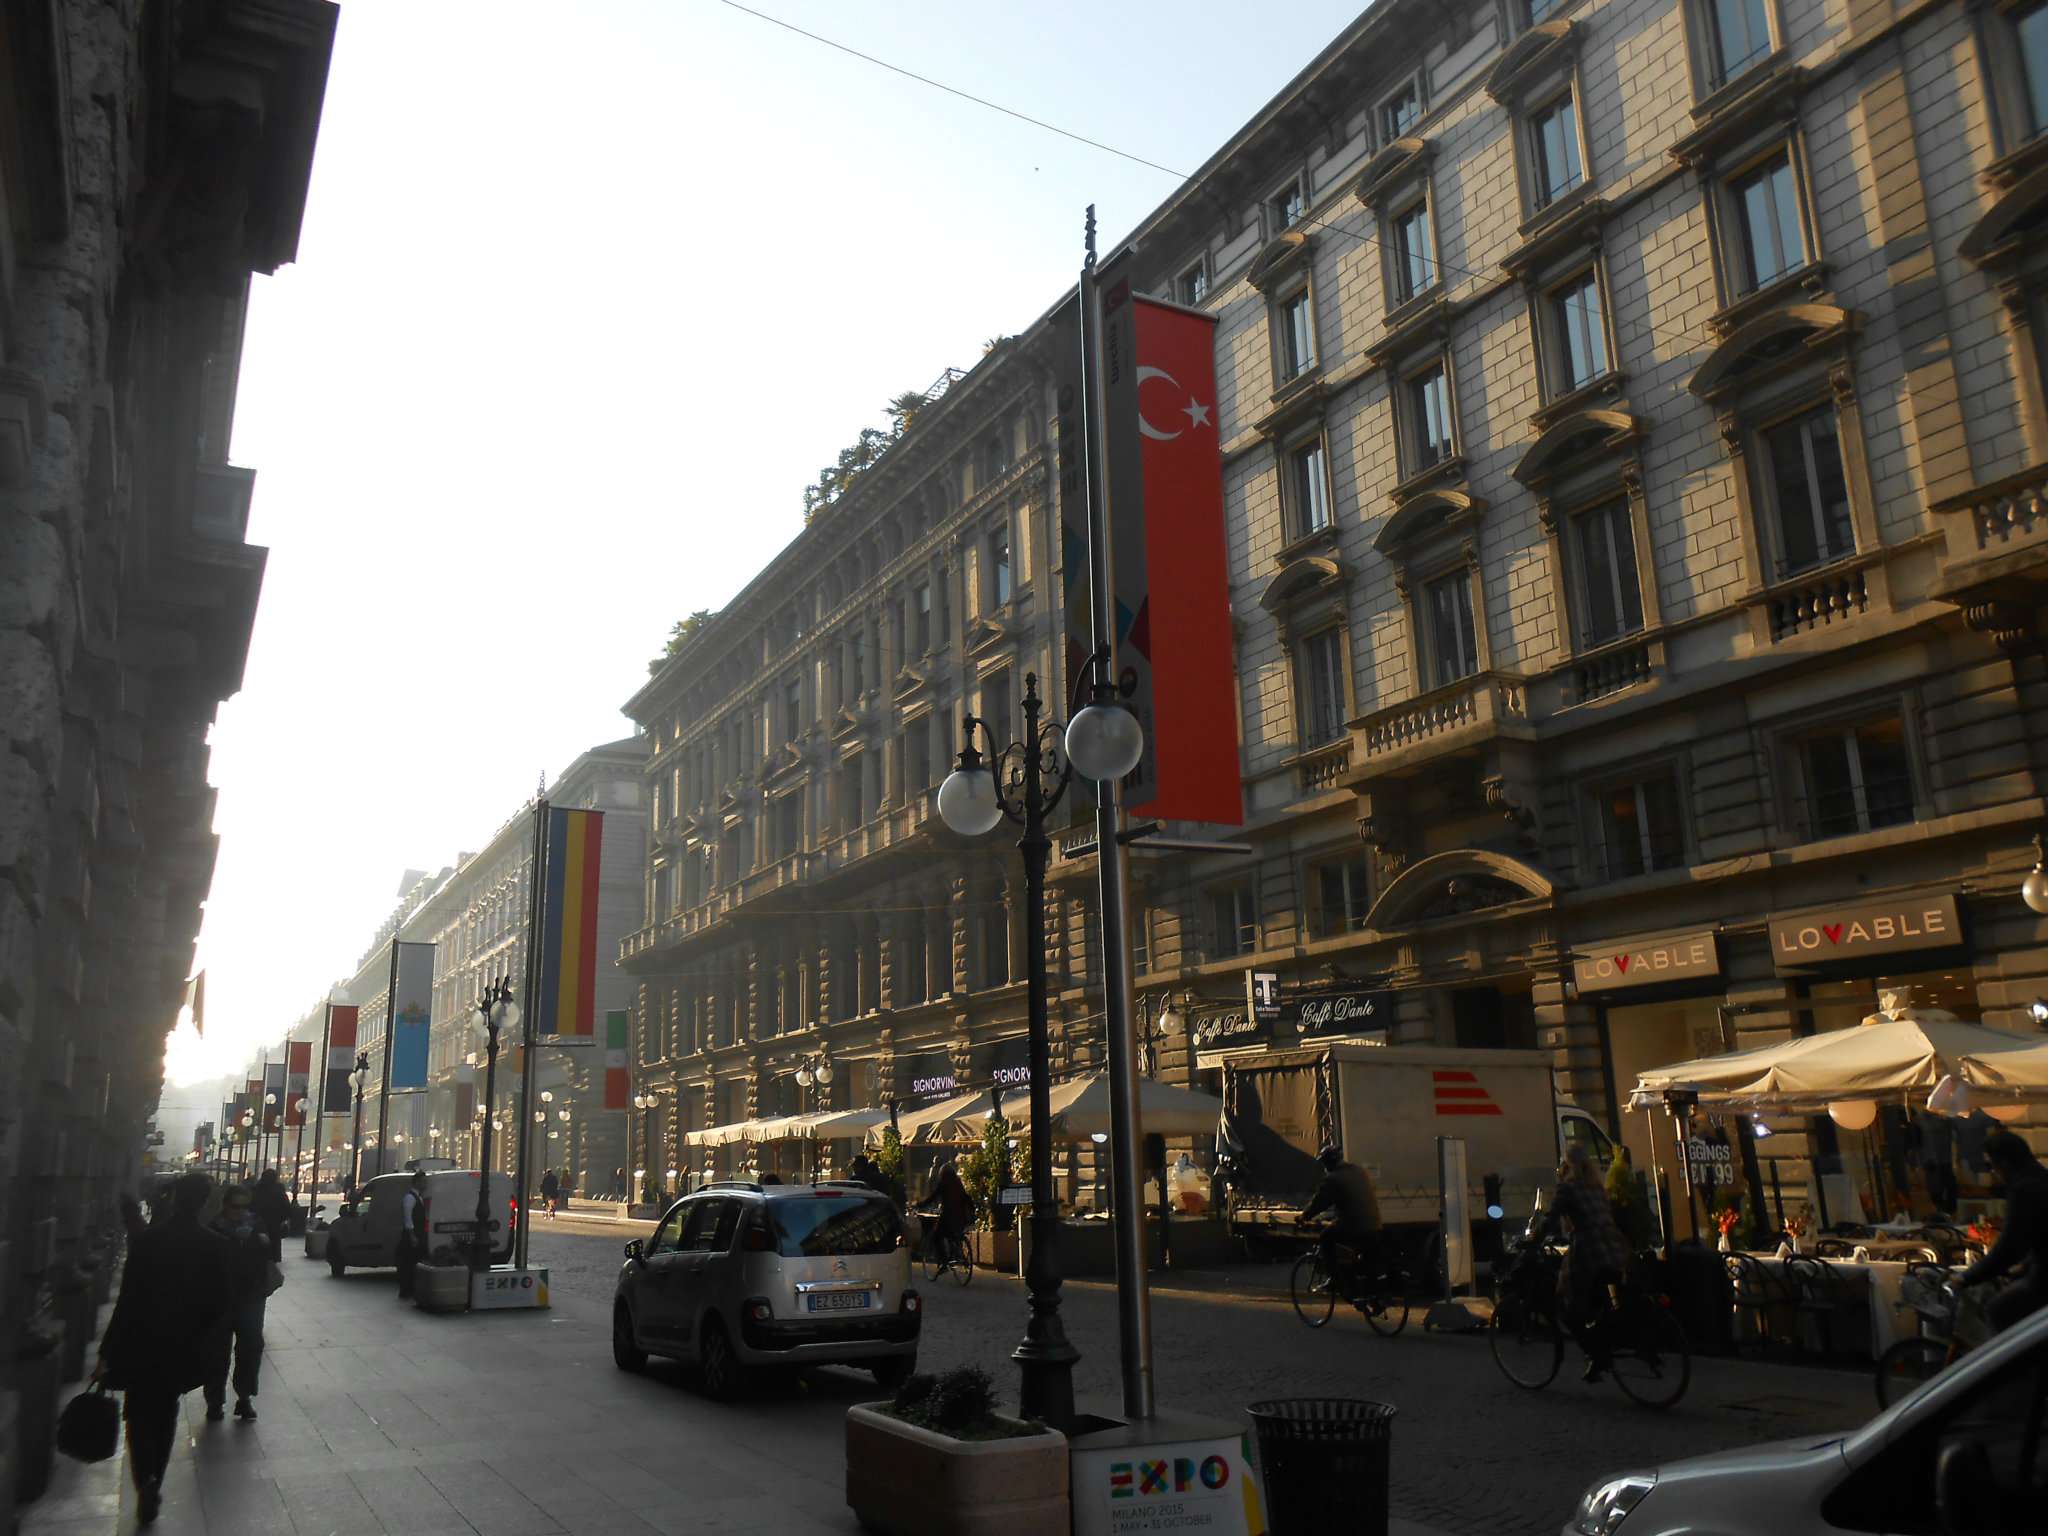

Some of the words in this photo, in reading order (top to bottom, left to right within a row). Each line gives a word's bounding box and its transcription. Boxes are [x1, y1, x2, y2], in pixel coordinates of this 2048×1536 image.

[1334, 997, 1375, 1021] Dante
[1223, 1014, 1257, 1036] Dante
[1676, 1143, 1730, 1161] LGGINGS
[1110, 1455, 1229, 1498] EXPO
[1112, 1505, 1156, 1521] MILANO
[1159, 1503, 1185, 1516] 2015
